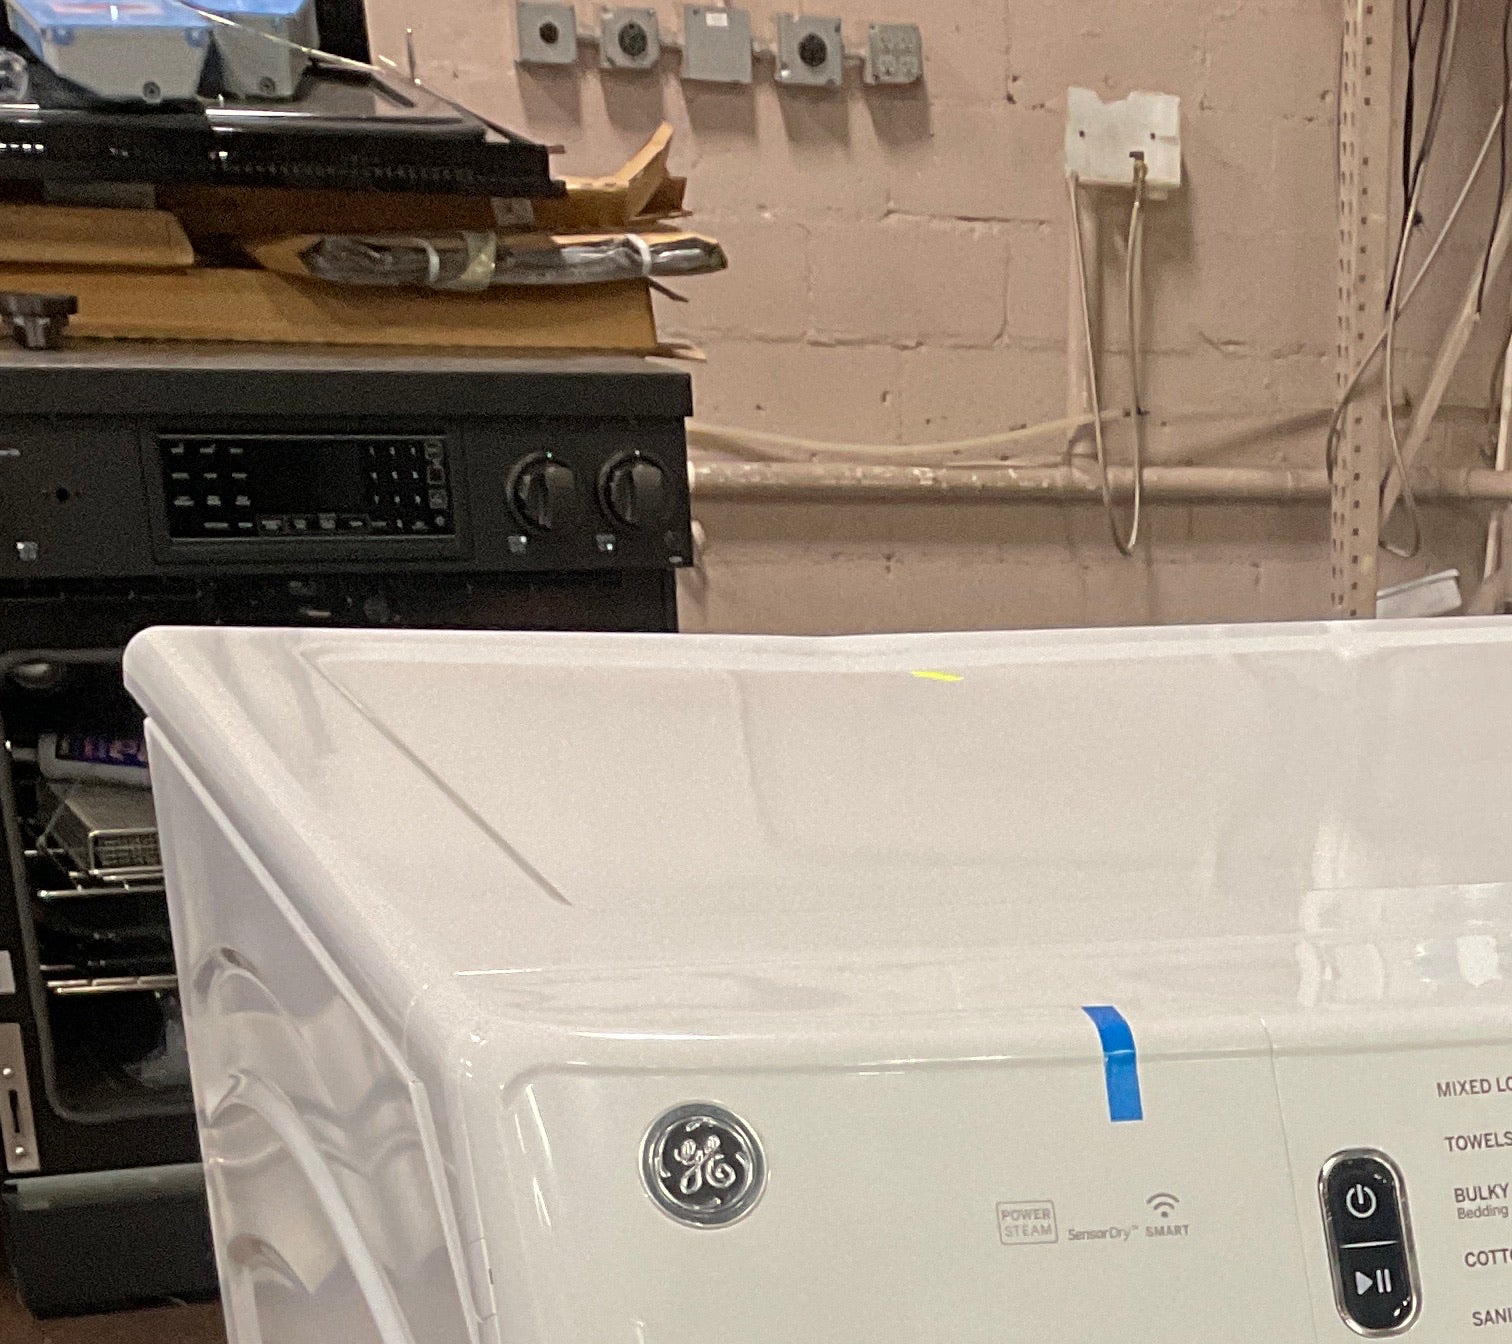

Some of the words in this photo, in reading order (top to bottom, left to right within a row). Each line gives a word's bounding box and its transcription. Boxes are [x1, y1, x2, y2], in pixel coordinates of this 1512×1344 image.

[1436, 1078, 1492, 1098] MIXED
[1453, 1182, 1510, 1203] BULKY
[1000, 1208, 1051, 1222] POWER
[1456, 1205, 1509, 1220] Bedding
[1004, 1223, 1053, 1238] STEAM
[1144, 1224, 1190, 1238] SMART
